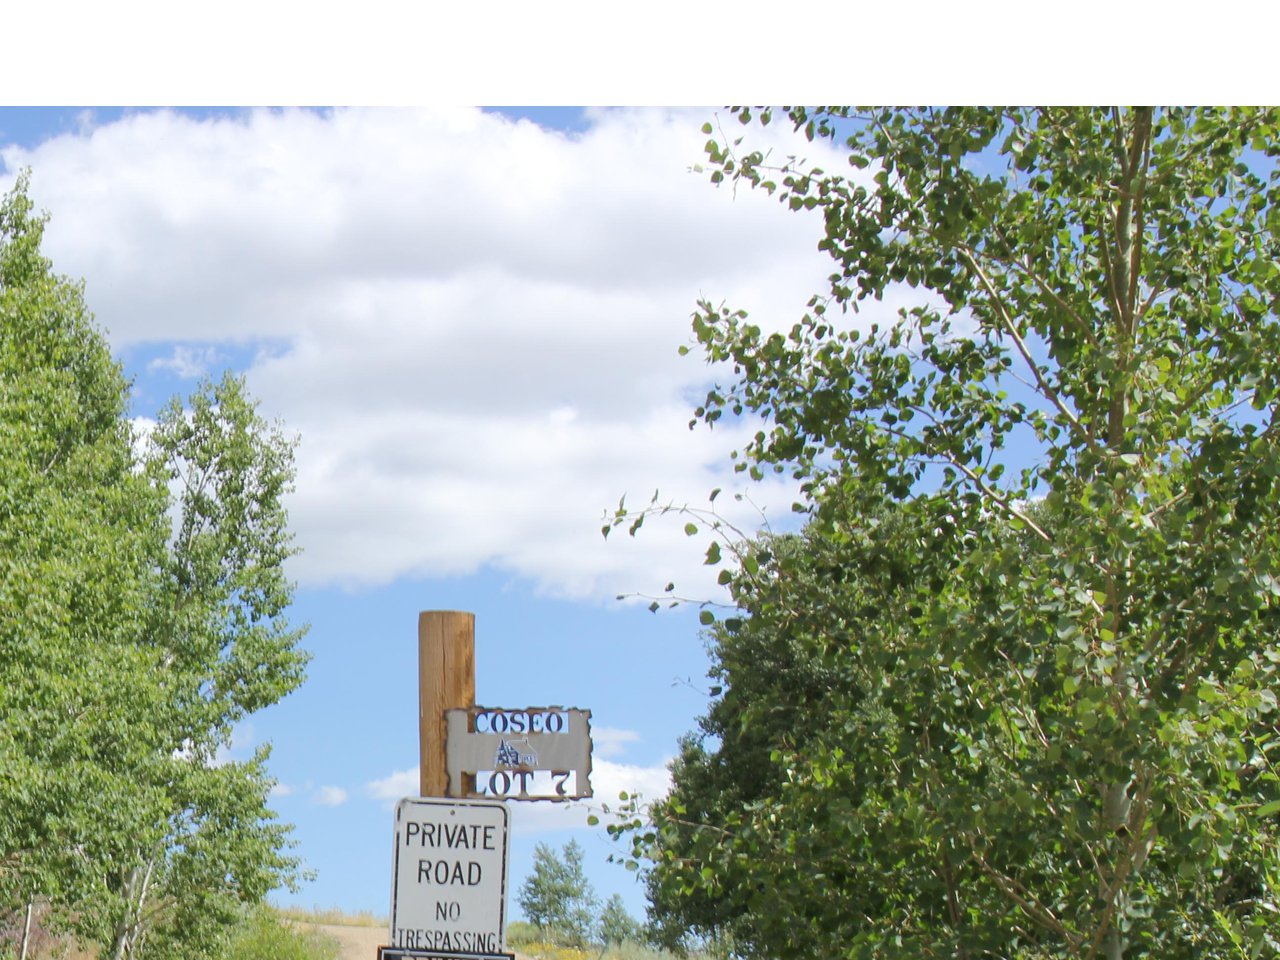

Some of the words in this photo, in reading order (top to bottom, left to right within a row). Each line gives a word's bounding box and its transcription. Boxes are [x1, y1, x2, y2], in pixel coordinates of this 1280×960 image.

[467, 770, 534, 797] LOT
[551, 770, 571, 797] 7
[406, 821, 496, 850] PRIVATE
[418, 859, 482, 886] ROAD
[435, 901, 461, 922] NO
[397, 928, 497, 953] TRESPASSING
